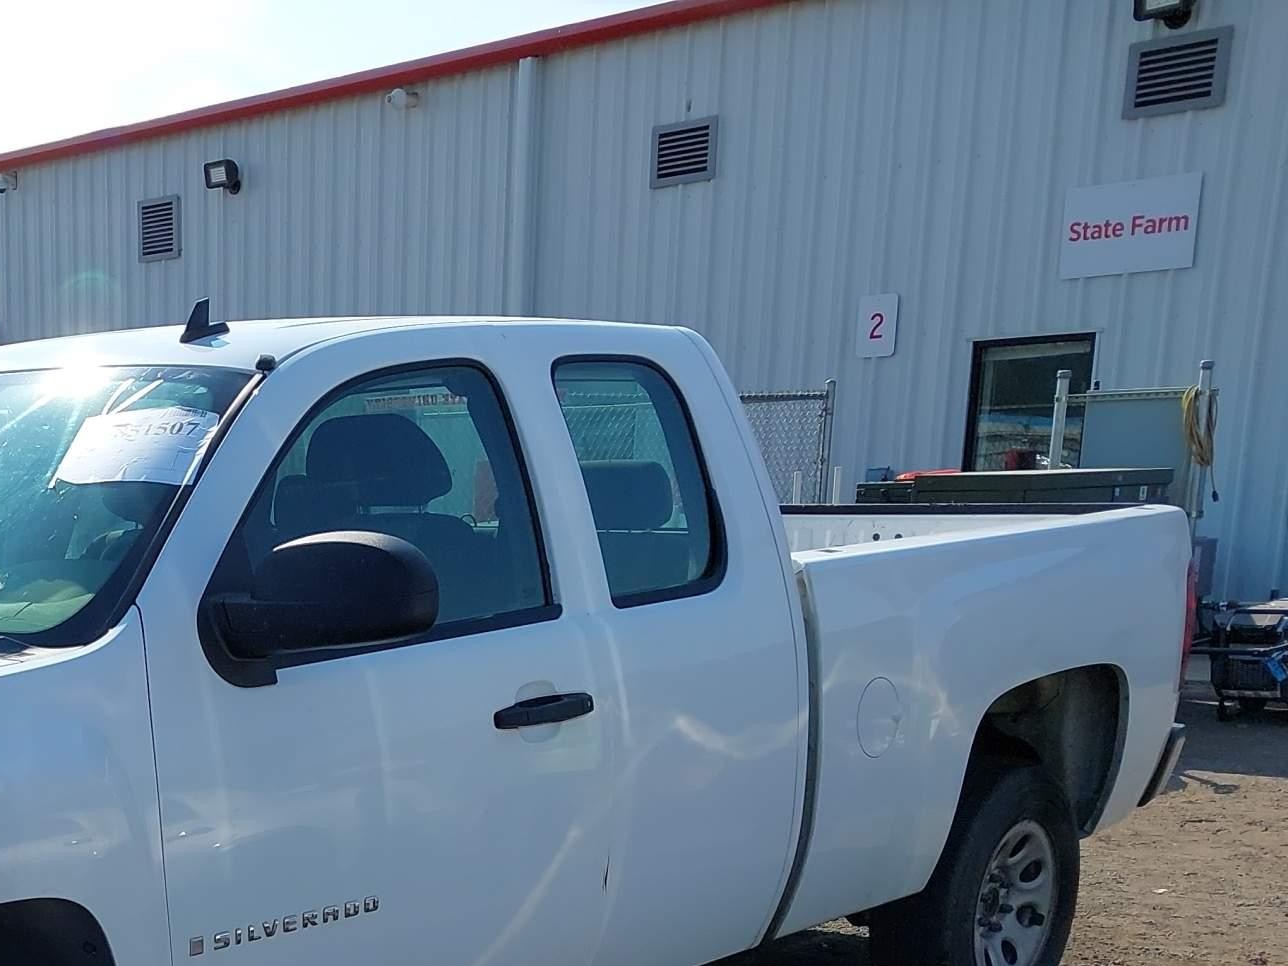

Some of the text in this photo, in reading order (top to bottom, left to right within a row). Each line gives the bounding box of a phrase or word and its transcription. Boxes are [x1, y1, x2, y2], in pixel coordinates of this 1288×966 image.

[1069, 214, 1190, 242] State Farm
[869, 312, 884, 340] 2
[213, 895, 380, 950] SILVERADO
